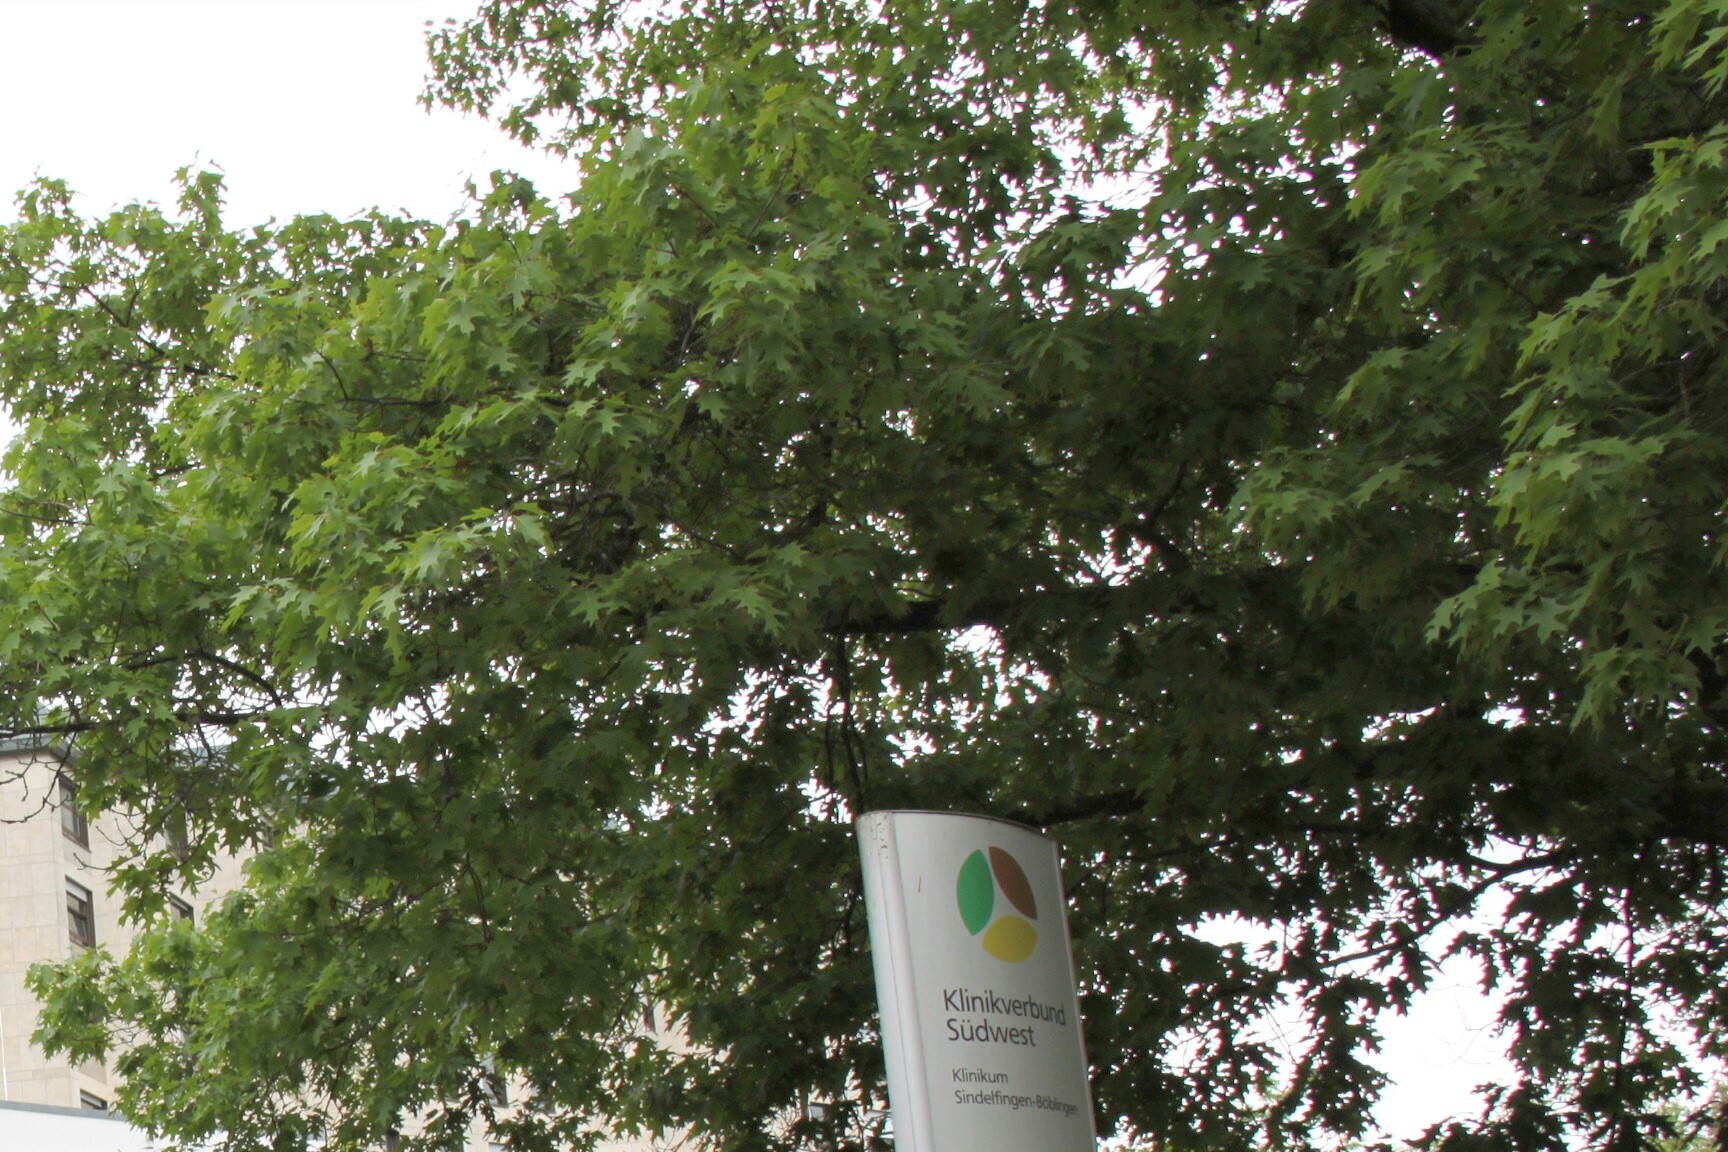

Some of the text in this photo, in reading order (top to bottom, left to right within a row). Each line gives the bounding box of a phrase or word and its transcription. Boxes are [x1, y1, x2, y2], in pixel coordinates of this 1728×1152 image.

[943, 988, 1066, 1026] Klinikverbund
[946, 1018, 1036, 1047] Südwest
[952, 1068, 1009, 1084] Klinikum
[954, 1089, 1079, 1118] Sindelfingen-Böblingen
